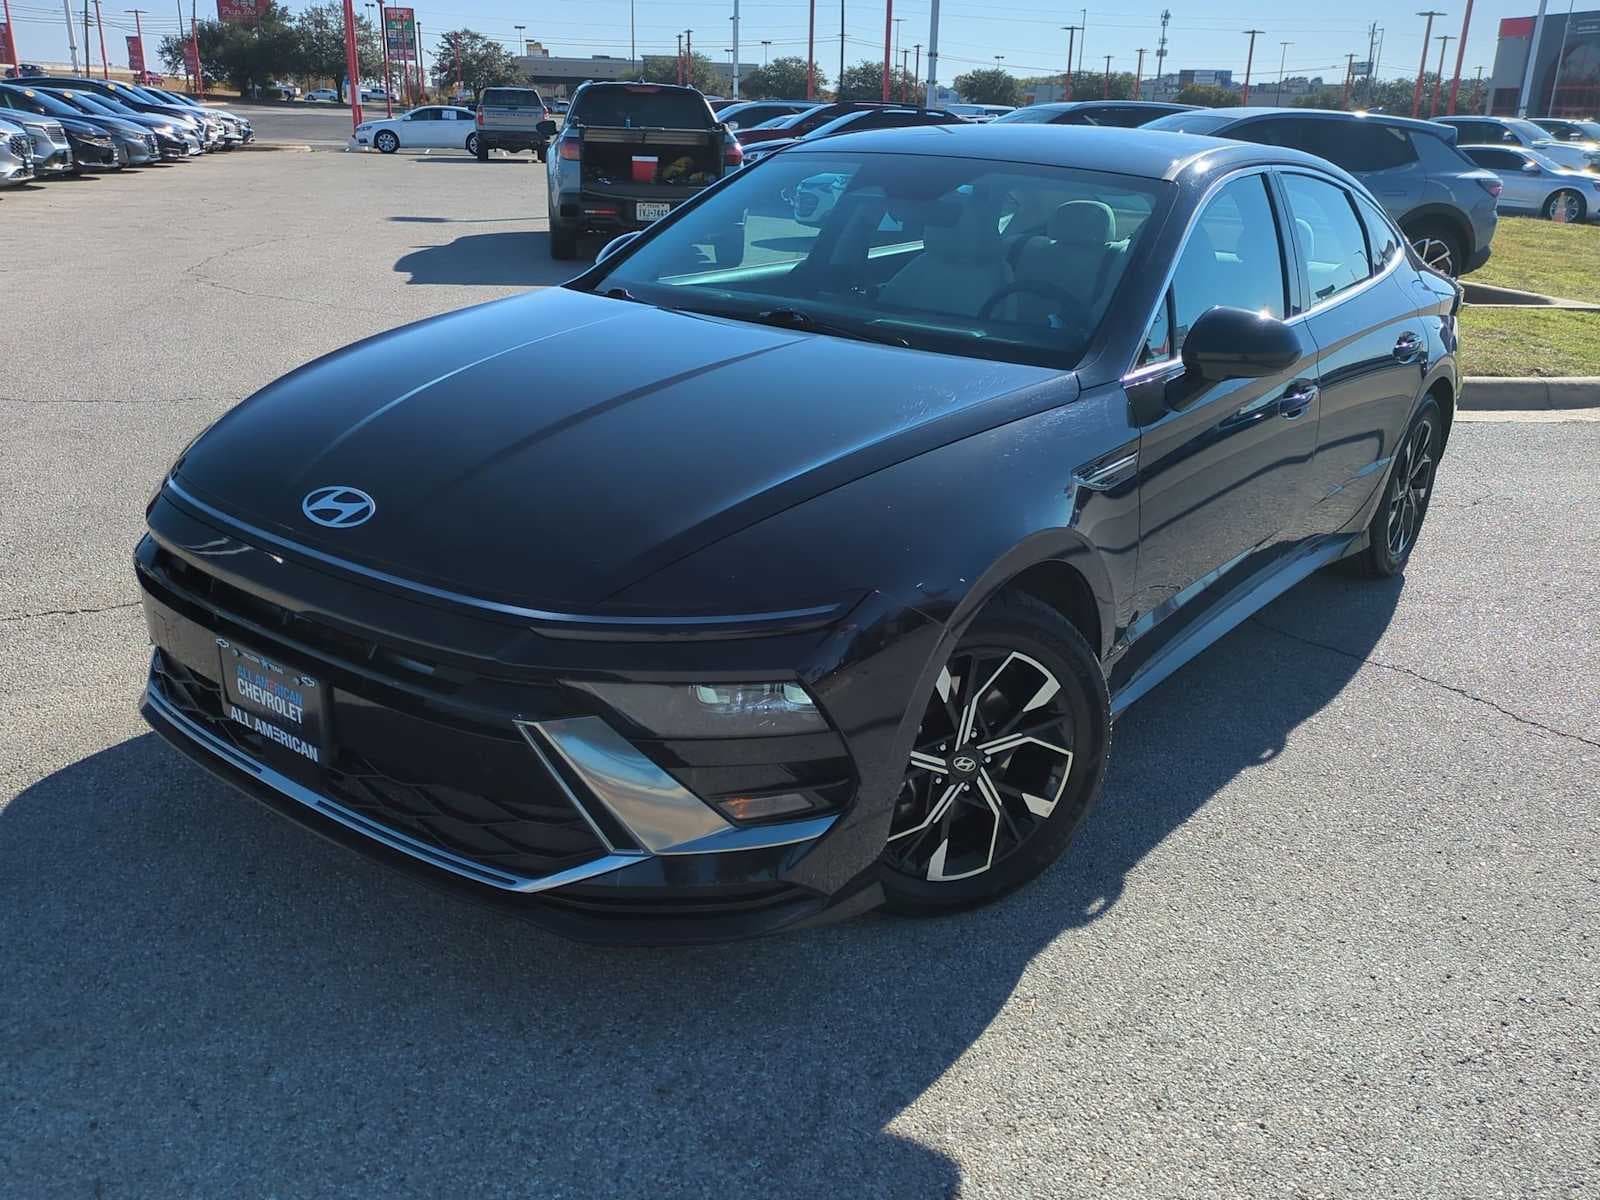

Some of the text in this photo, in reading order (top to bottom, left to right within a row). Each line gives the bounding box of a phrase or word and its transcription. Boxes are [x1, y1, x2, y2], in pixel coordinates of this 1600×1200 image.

[237, 678, 304, 724] CHEVROLET
[231, 706, 318, 762] ALL AMERICAN
